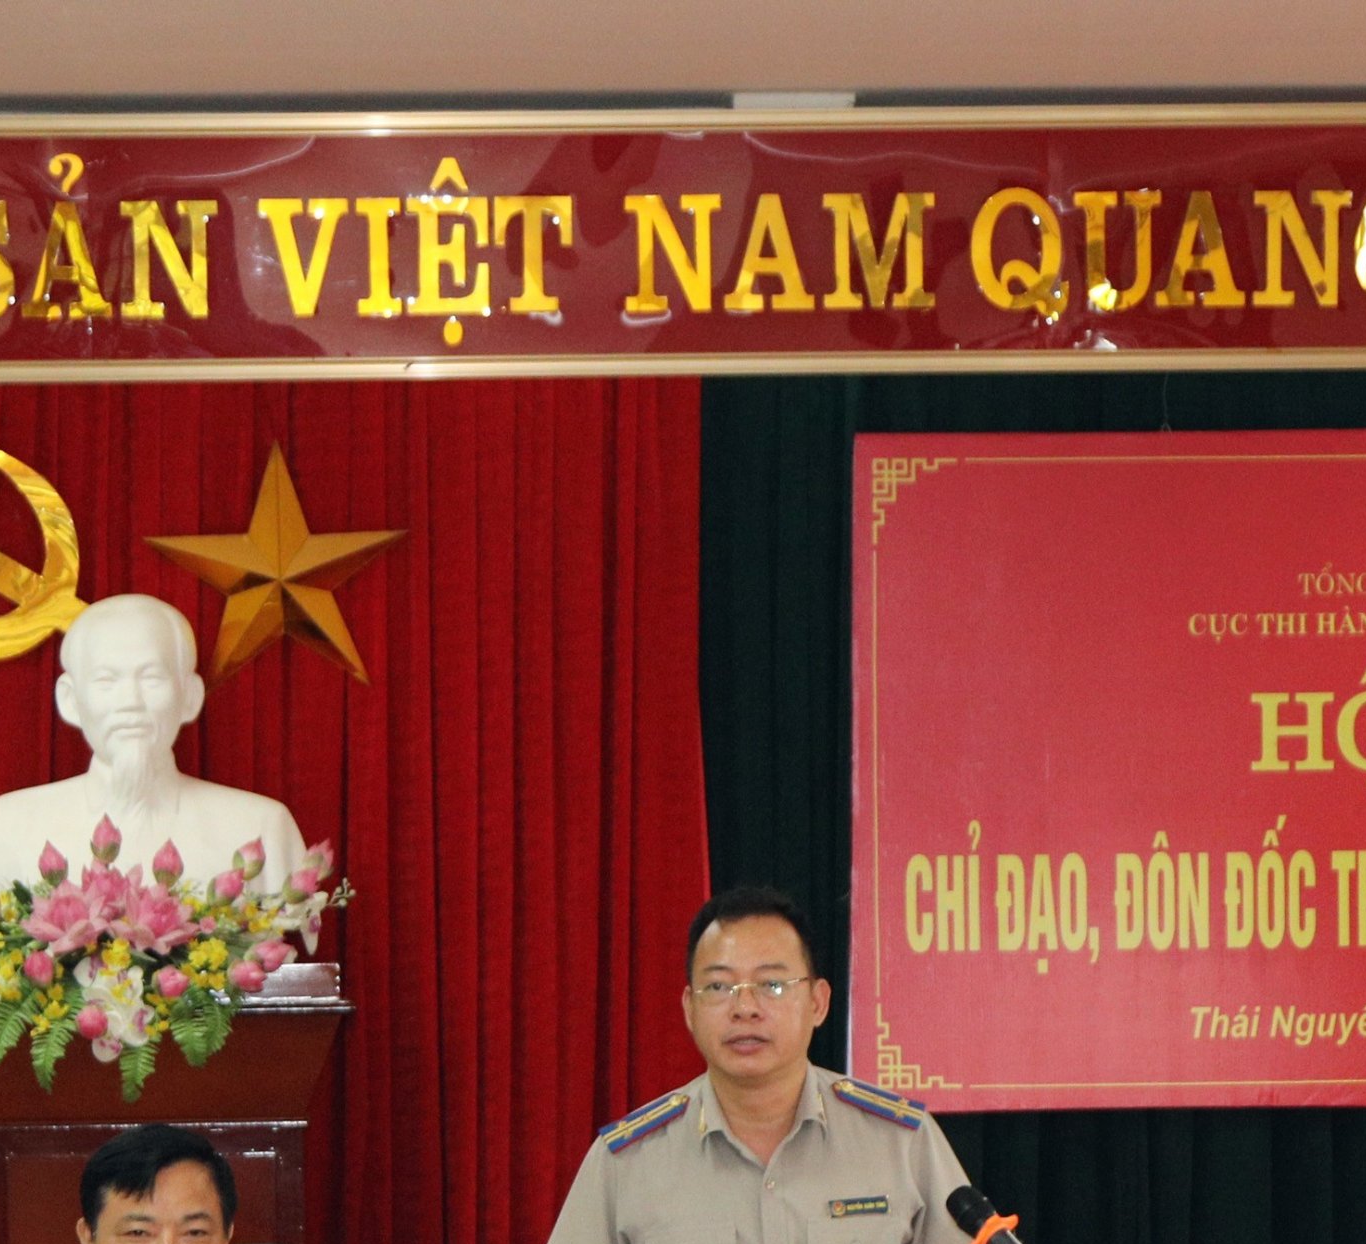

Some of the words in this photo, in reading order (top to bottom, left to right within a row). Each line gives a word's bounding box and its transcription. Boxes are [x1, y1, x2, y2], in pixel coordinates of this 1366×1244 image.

[257, 156, 576, 347] VIỆT
[622, 191, 938, 314] NAM
[1187, 613, 1248, 643] CỤC
[1256, 613, 1308, 636] THI
[904, 820, 983, 953] CHỈ
[996, 852, 1102, 975] ĐẠO,
[1114, 831, 1211, 951] ĐÔN
[1224, 815, 1319, 950] ĐỐC
[1190, 1005, 1262, 1038] Thái
